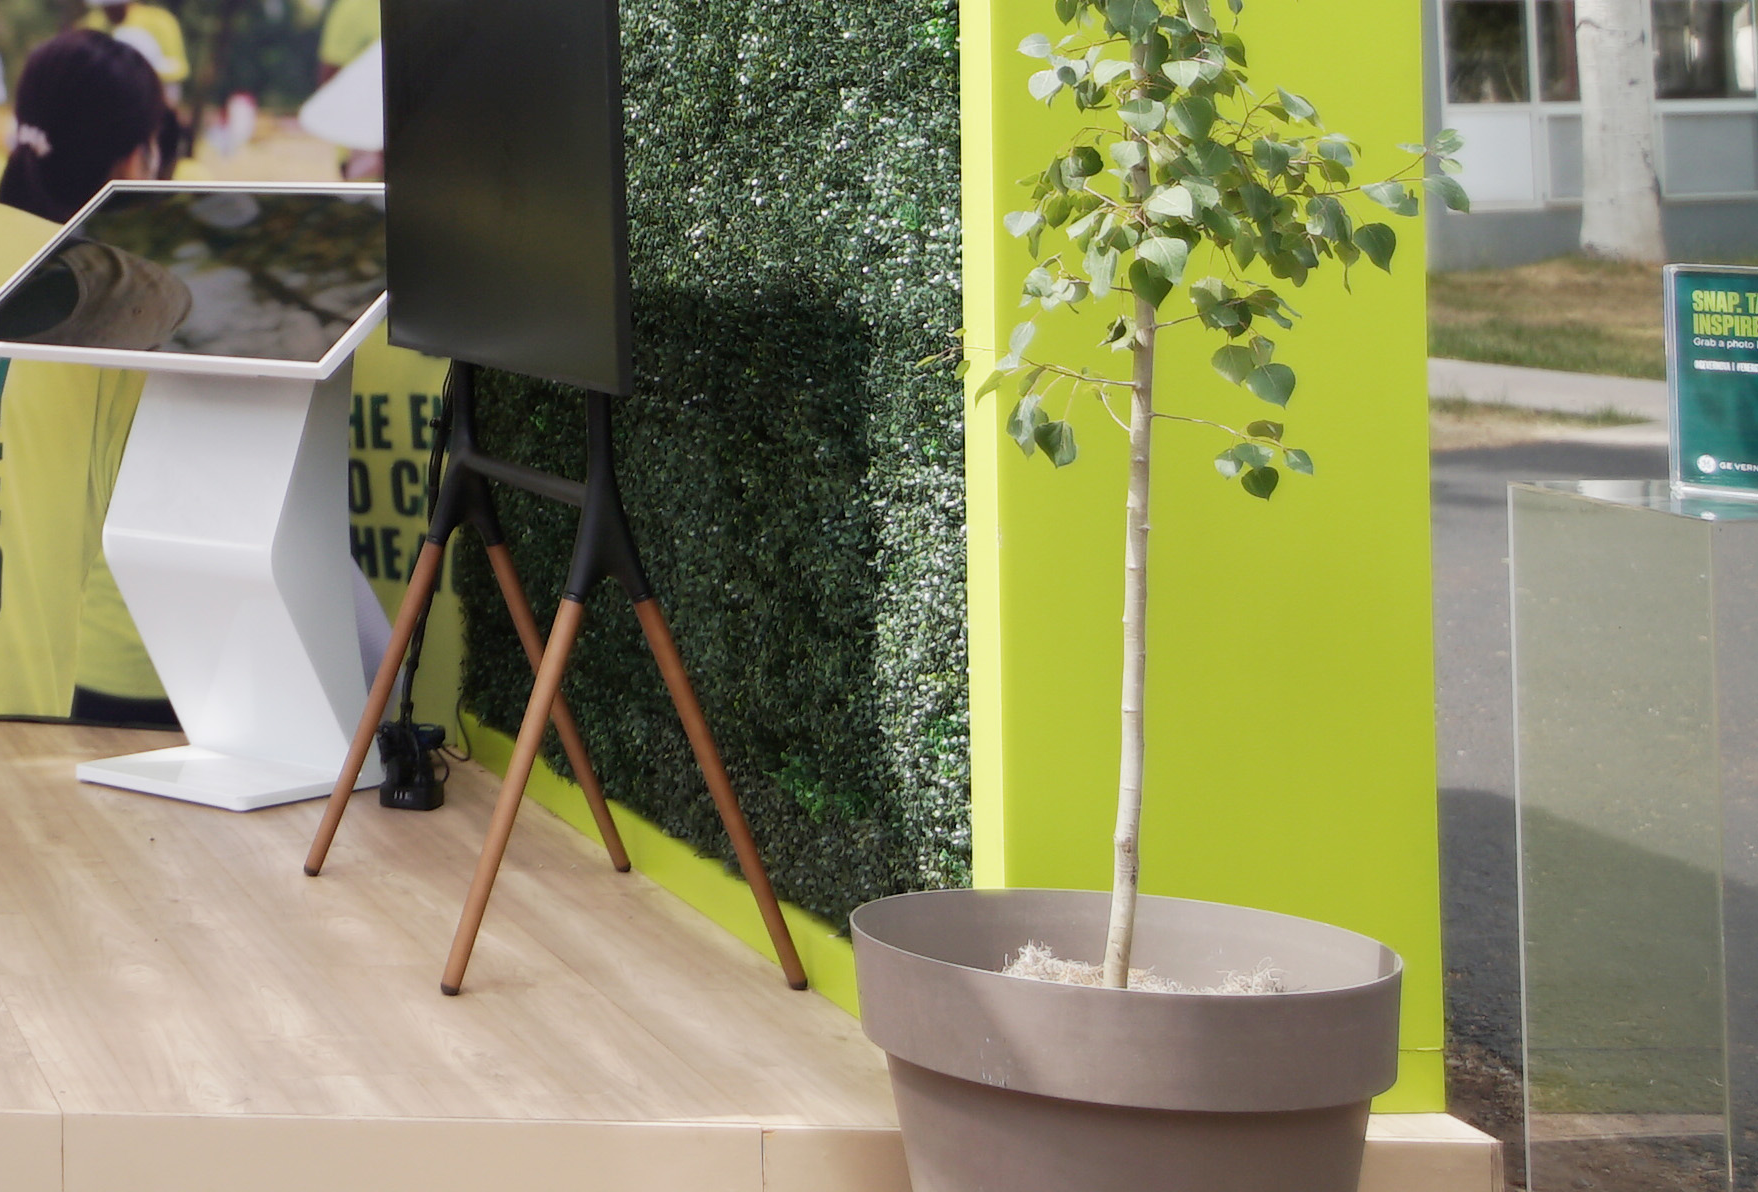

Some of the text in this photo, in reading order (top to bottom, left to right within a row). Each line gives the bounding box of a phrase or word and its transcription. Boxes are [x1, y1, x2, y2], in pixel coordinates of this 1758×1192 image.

[1692, 290, 1742, 313] SNAP.
[1693, 337, 1754, 349] Grab a photo
[349, 394, 392, 449] HE
[1719, 462, 1732, 470] GE
[350, 525, 401, 580] HE
